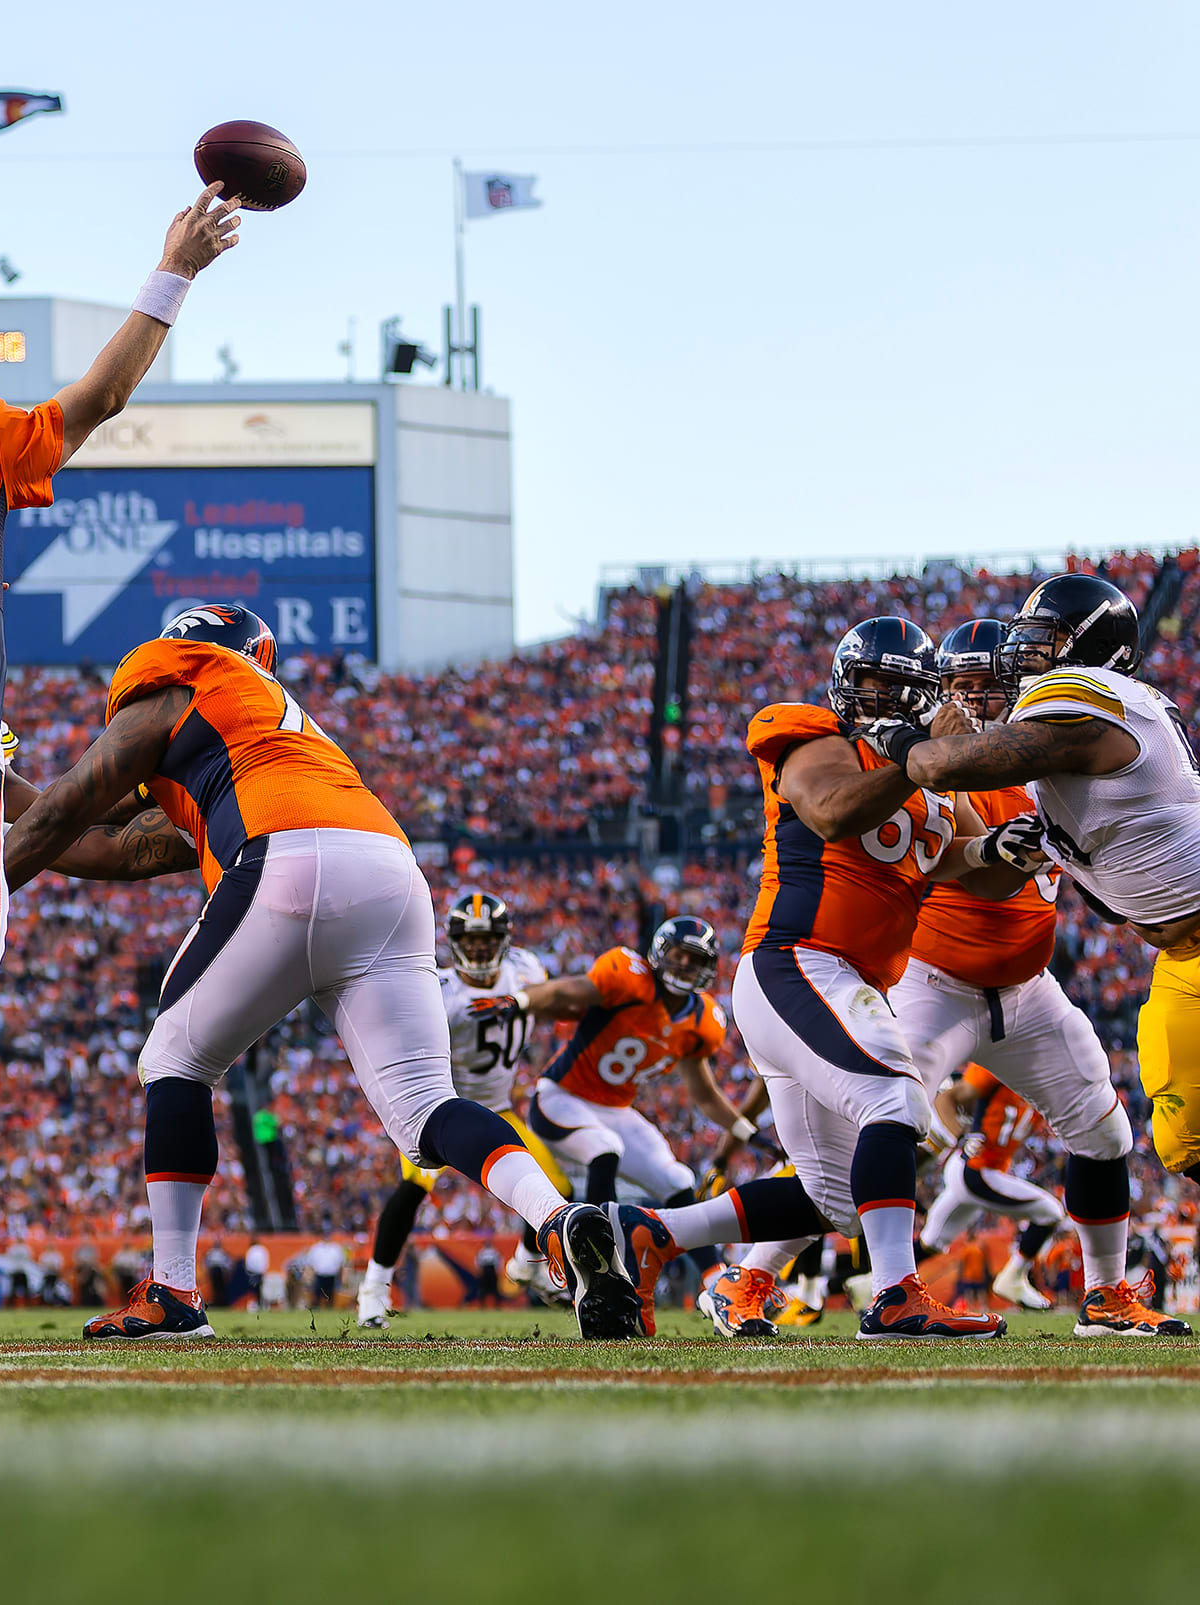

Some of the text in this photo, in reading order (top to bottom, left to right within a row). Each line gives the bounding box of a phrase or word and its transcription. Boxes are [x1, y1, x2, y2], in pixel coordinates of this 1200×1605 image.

[194, 526, 366, 563] Hospitals
[859, 786, 957, 876] 65
[468, 1013, 528, 1074] 50
